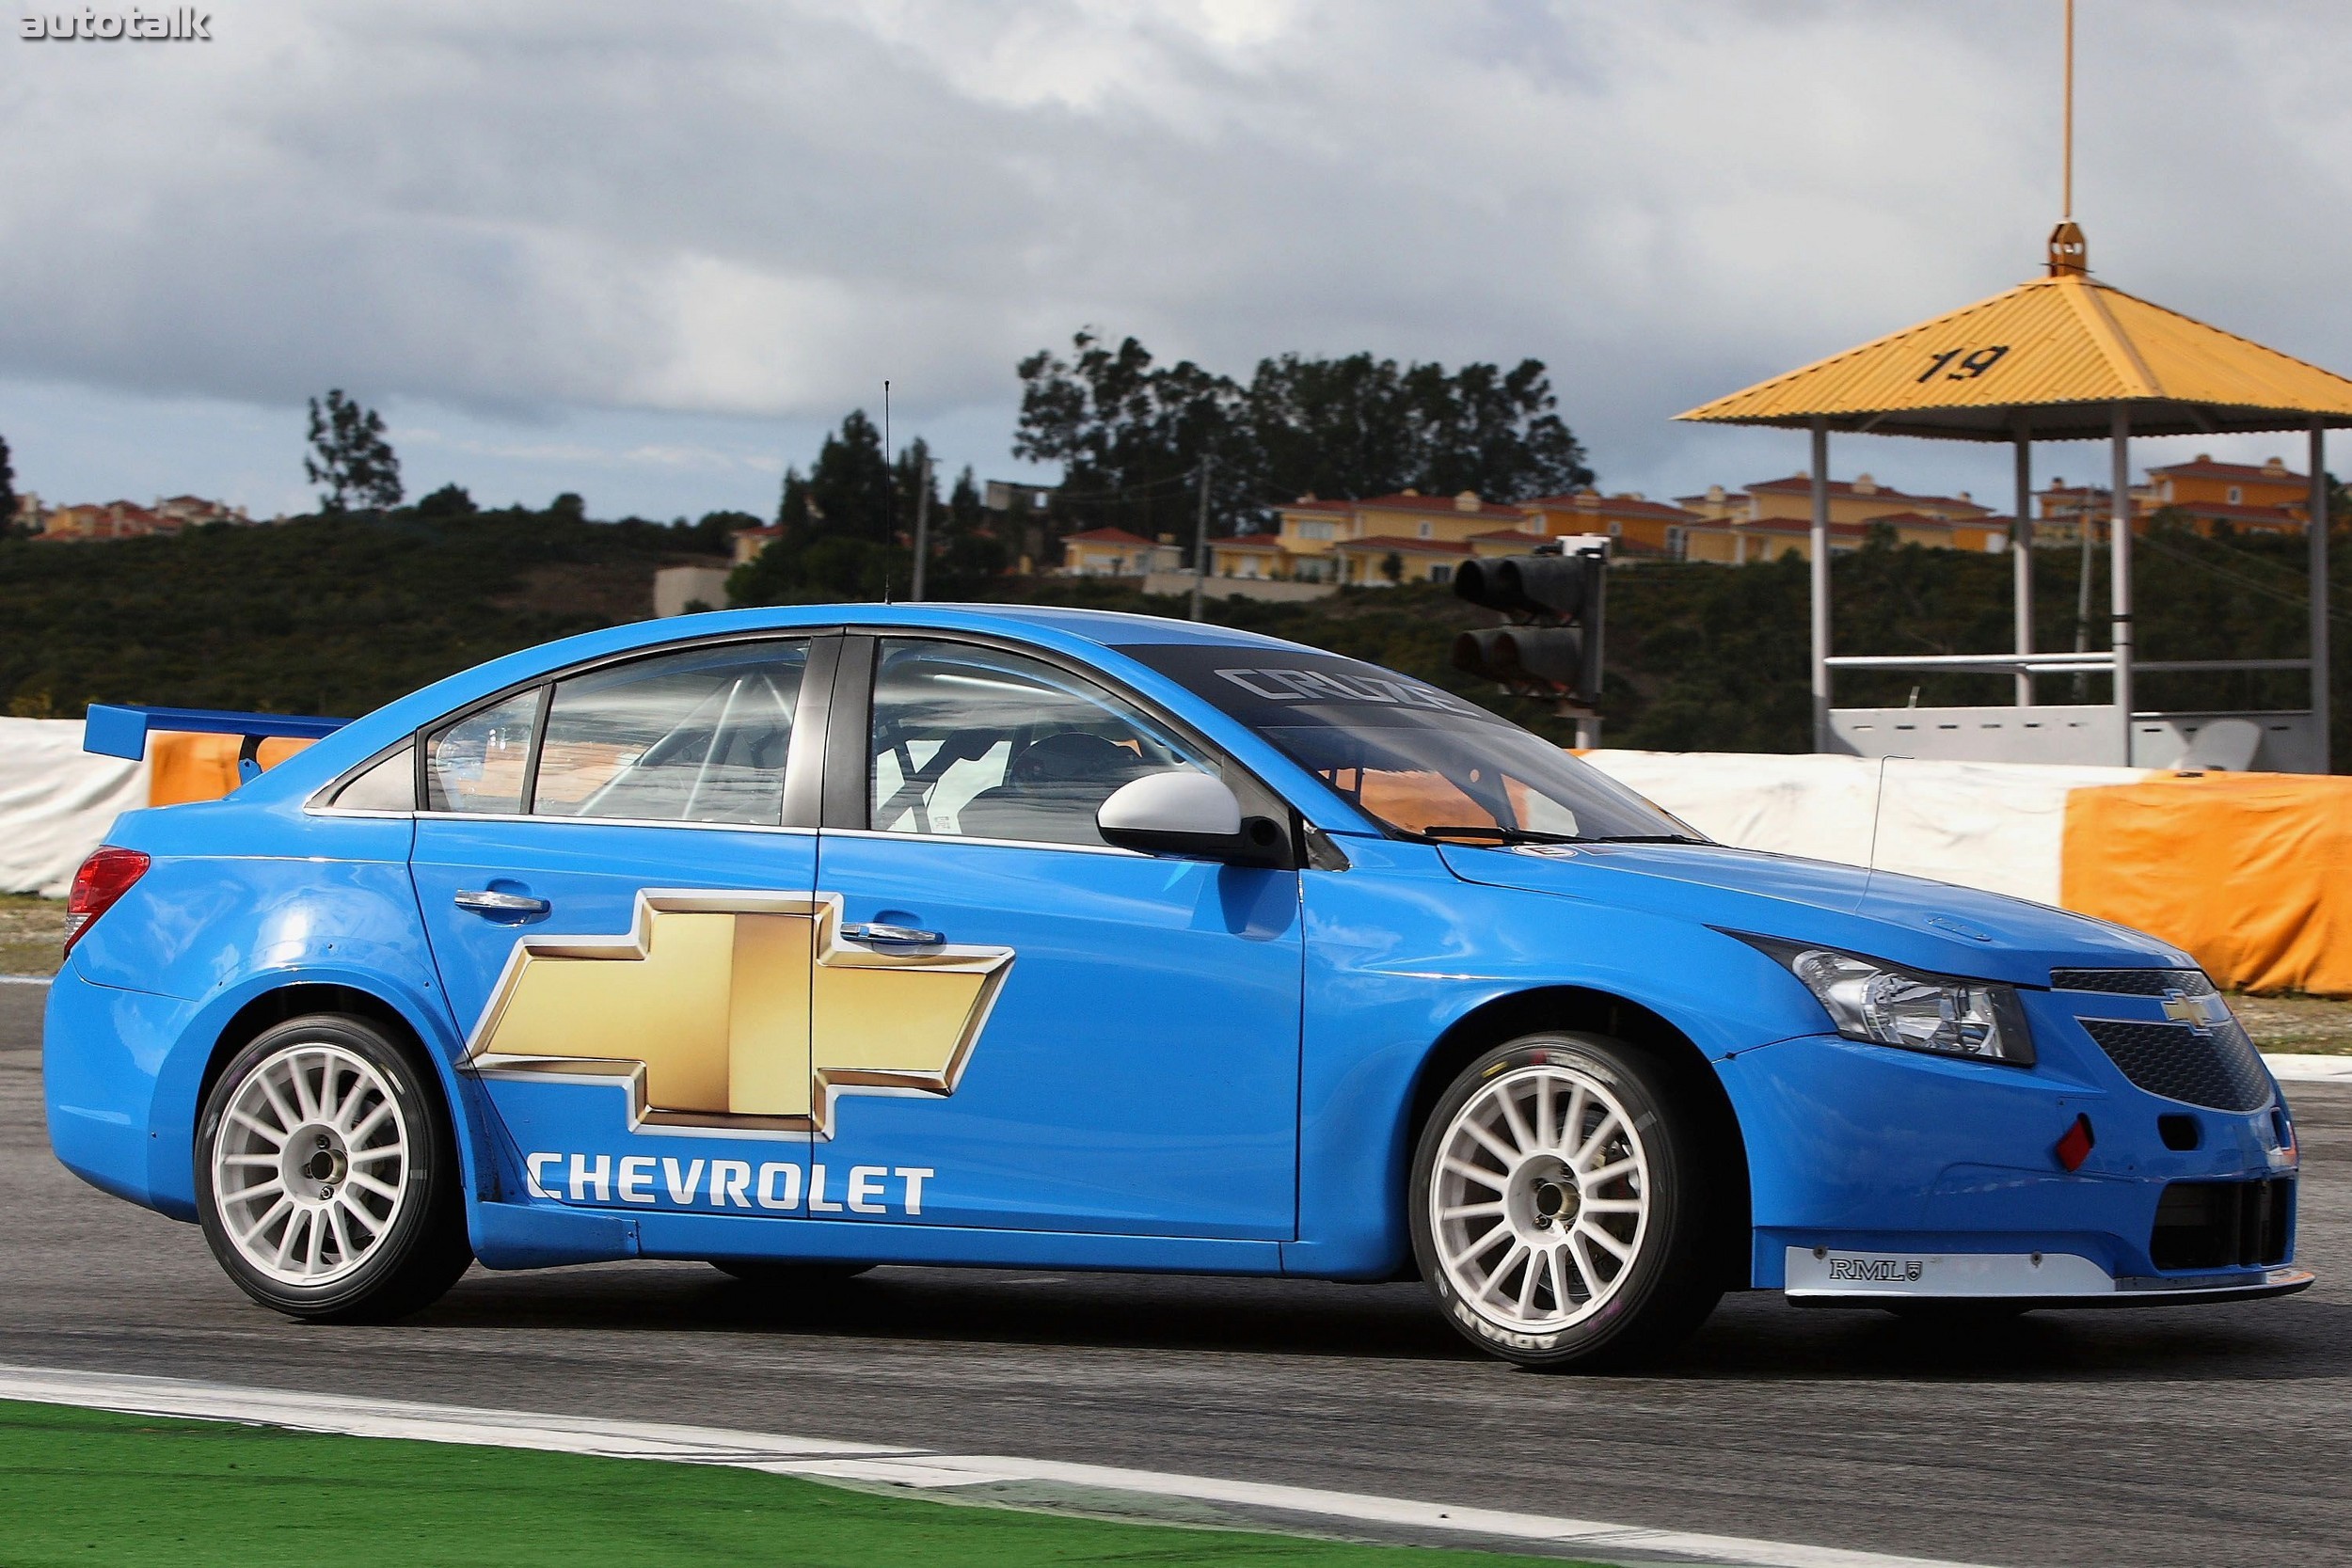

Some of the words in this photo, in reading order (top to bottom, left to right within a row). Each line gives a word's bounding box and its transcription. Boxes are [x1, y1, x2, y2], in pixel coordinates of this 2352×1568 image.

[1917, 345, 2010, 383] 19
[527, 1152, 934, 1214] CHEVROLET
[1830, 1259, 1905, 1281] RML
